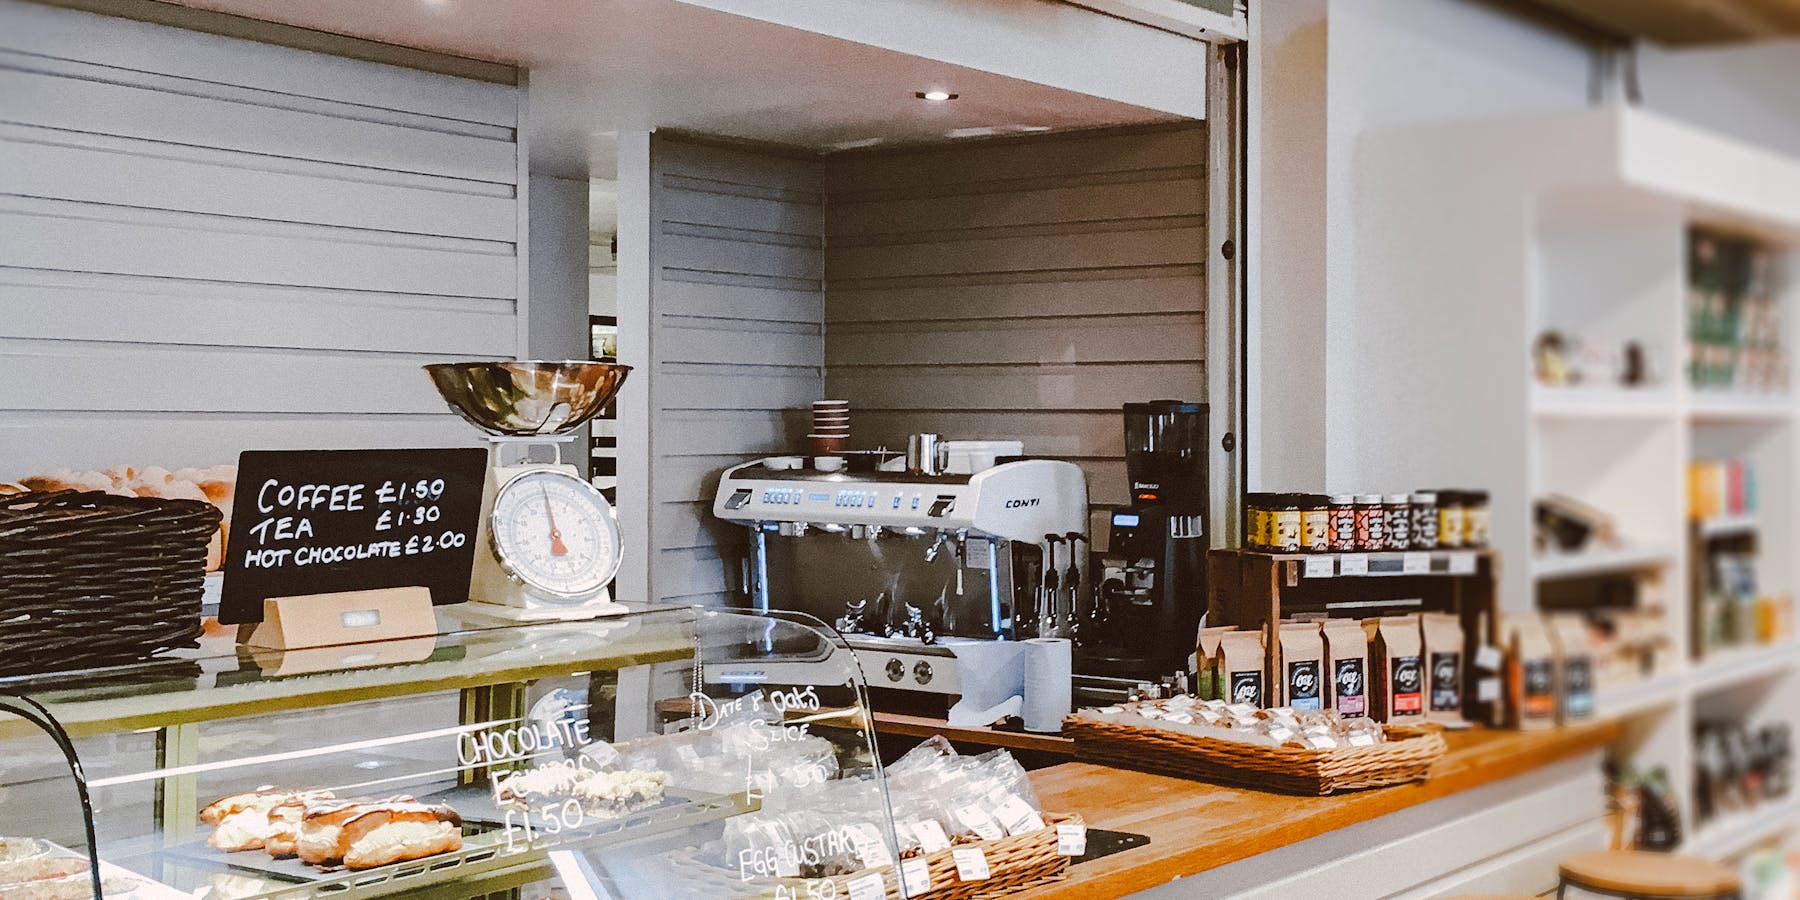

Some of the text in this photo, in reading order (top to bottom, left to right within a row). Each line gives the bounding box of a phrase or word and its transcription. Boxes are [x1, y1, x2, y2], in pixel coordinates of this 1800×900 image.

[257, 478, 446, 514] COFFEE £1.50
[1004, 498, 1041, 509] CONTI
[249, 505, 441, 545] TEA £1.30
[244, 530, 466, 568] HOT CHOCOLATE £2.00
[456, 718, 593, 766] CHOCOLATE
[743, 718, 810, 751] SLICE
[744, 754, 828, 807] £150
[502, 798, 584, 852] £1.50
[738, 846, 779, 883] EGG
[774, 879, 836, 900] £150
